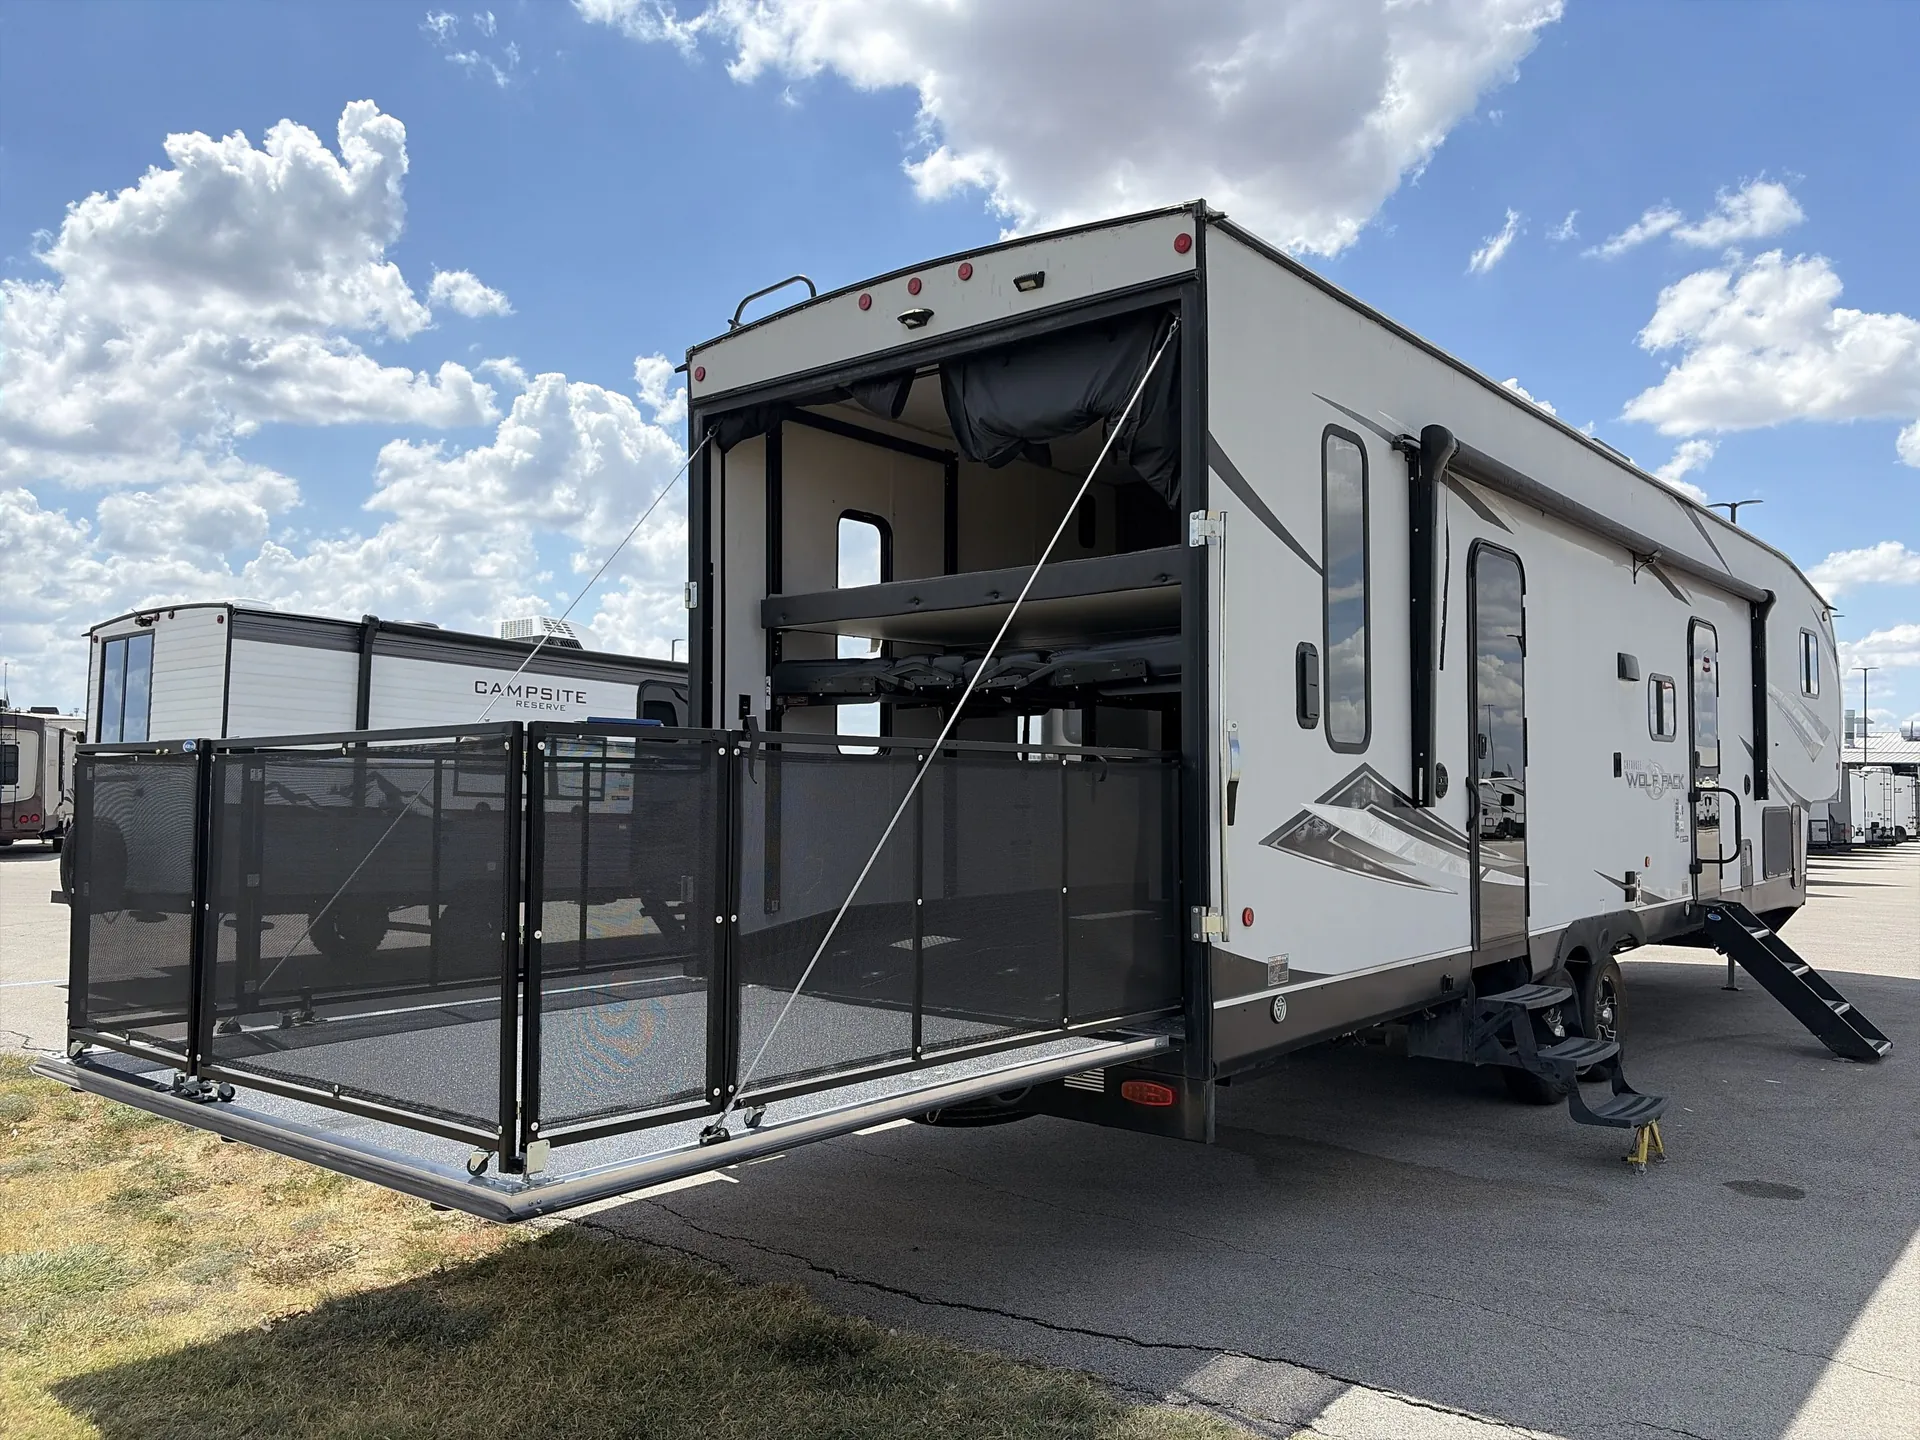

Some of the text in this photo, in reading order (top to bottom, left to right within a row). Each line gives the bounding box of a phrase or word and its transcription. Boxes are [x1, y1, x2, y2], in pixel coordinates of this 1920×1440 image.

[475, 681, 587, 704] CAMPSITE
[516, 700, 566, 711] RESERVE
[1624, 771, 1685, 790] WOLF PACK
